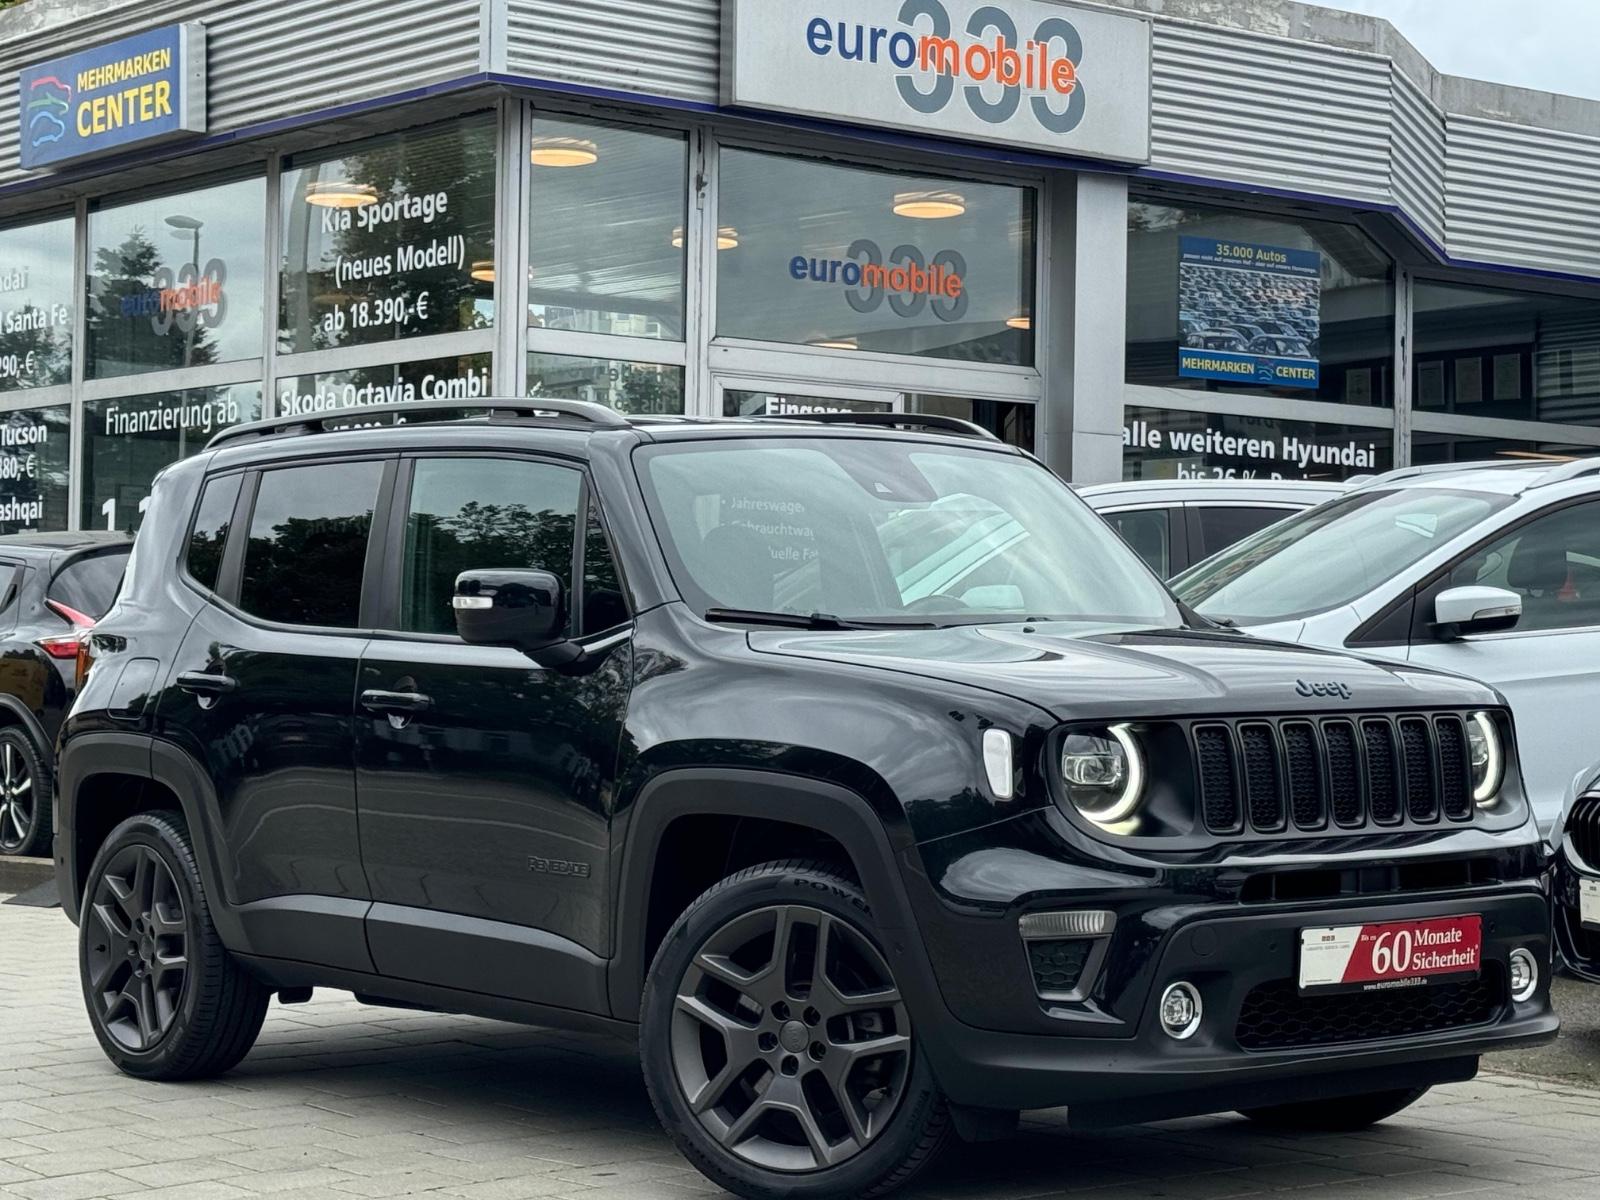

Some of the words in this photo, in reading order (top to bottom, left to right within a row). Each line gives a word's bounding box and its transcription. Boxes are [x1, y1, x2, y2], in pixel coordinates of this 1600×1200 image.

[77, 48, 171, 93] MEHRMARKEN
[806, 16, 1076, 94] euromobile
[77, 80, 172, 137] CENTER
[321, 205, 351, 233] Kia
[357, 191, 448, 232] Sportage
[335, 255, 391, 289] (neues
[397, 235, 465, 272] Modell)
[1216, 244, 1253, 258] 35.000
[1256, 249, 1287, 262] Autos
[0, 267, 25, 291] dai
[789, 255, 962, 298] euromobile
[844, 239, 969, 322] 333
[6, 308, 46, 334] Santa
[51, 303, 68, 325] Fe
[324, 304, 345, 332] ab
[350, 291, 429, 328] 18.390,-€
[0, 350, 34, 378] 90,-€
[1182, 357, 1254, 374] MEHRMARKEN
[1276, 366, 1316, 379] CENTER
[342, 377, 415, 409] Octavia
[421, 367, 487, 400] Combi
[766, 396, 853, 416] Einga
[0, 424, 47, 446] Tucson
[106, 401, 212, 435] Finanzierung
[217, 393, 237, 423] ab
[1122, 420, 1161, 448] alle
[1169, 428, 1275, 459] weiteren
[1283, 436, 1375, 468] Hyundai
[1295, 679, 1352, 700] Jeep
[1372, 930, 1411, 974] 60
[1413, 927, 1462, 946] Monate
